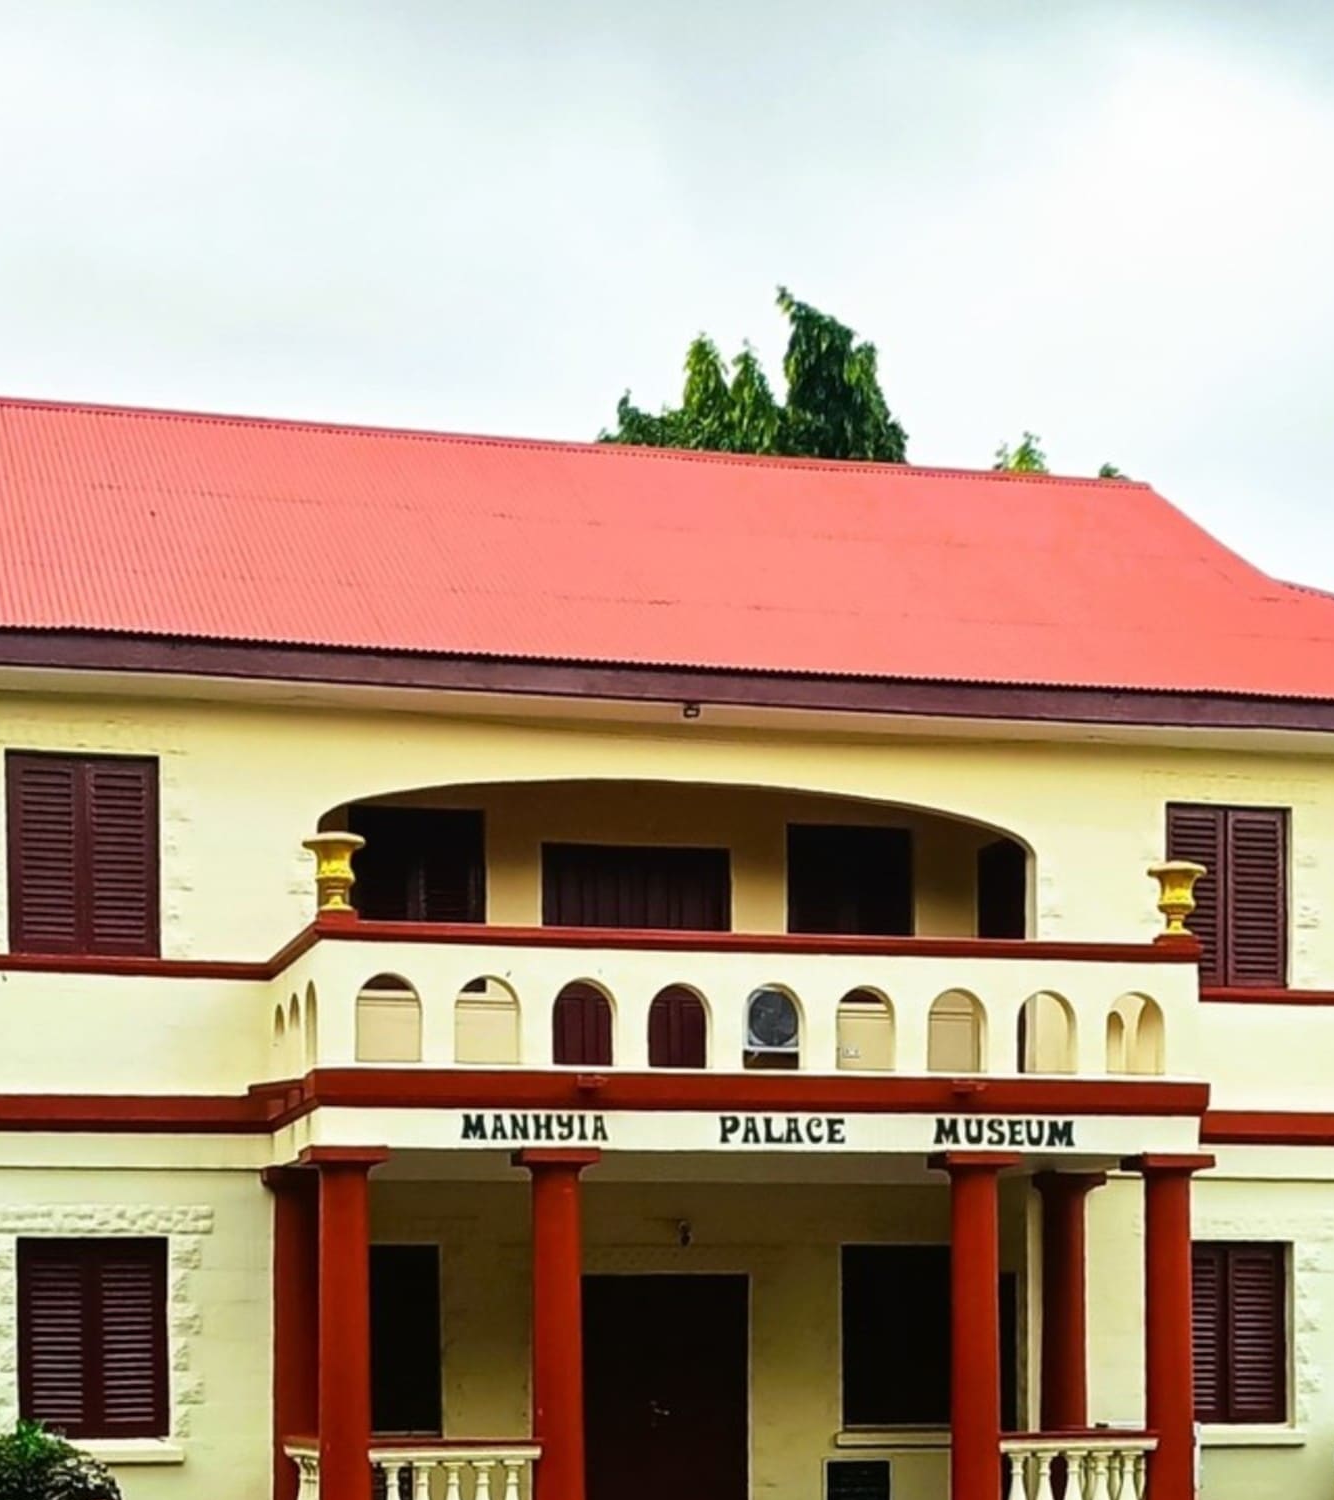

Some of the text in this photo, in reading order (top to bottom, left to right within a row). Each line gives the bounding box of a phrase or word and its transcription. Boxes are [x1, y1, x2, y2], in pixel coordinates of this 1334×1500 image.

[461, 1113, 1075, 1148] MANHYIA PALACE MUSEUM
